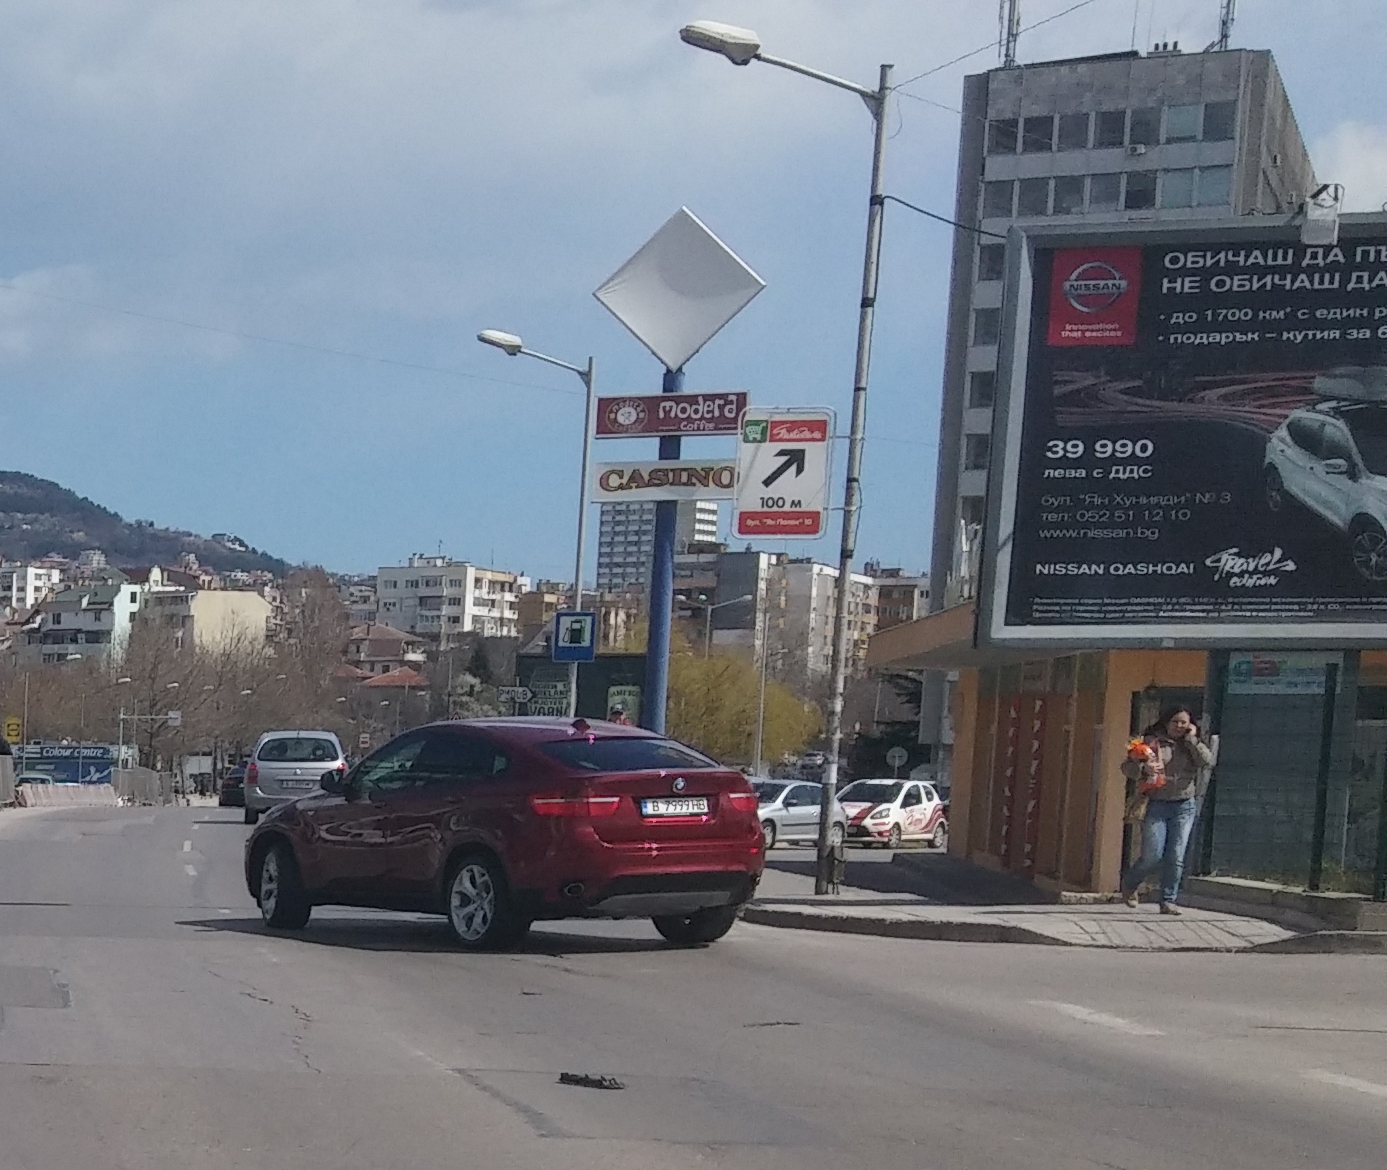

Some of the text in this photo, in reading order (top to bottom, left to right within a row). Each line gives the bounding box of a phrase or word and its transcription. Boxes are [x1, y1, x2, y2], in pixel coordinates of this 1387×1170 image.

[1164, 249, 1293, 269] ОБИЧАШ
[1301, 247, 1345, 267] ДА
[1069, 283, 1122, 292] NISSAN
[1161, 271, 1387, 294] НЕ ОБИЧАШ ДА
[1169, 308, 1197, 325] до
[1204, 307, 1254, 323] 1700
[1315, 306, 1369, 321] един
[1169, 330, 1259, 346] подарък
[1282, 327, 1341, 342] кутия
[1346, 328, 1371, 340] за
[1045, 438, 1154, 459] 39 990
[600, 466, 737, 492] CASINO
[1043, 465, 1153, 480] лева с ДДС
[760, 497, 786, 509] 100
[1220, 492, 1232, 504] 3
[1077, 509, 1109, 522] 052
[1114, 509, 1134, 522] 51
[1144, 509, 1163, 521] 12
[1170, 508, 1191, 521] 10
[1038, 527, 1159, 541] www.nissan.bg
[1035, 562, 1194, 576] NISSAN QASHQAI
[43, 747, 72, 757] Colour
